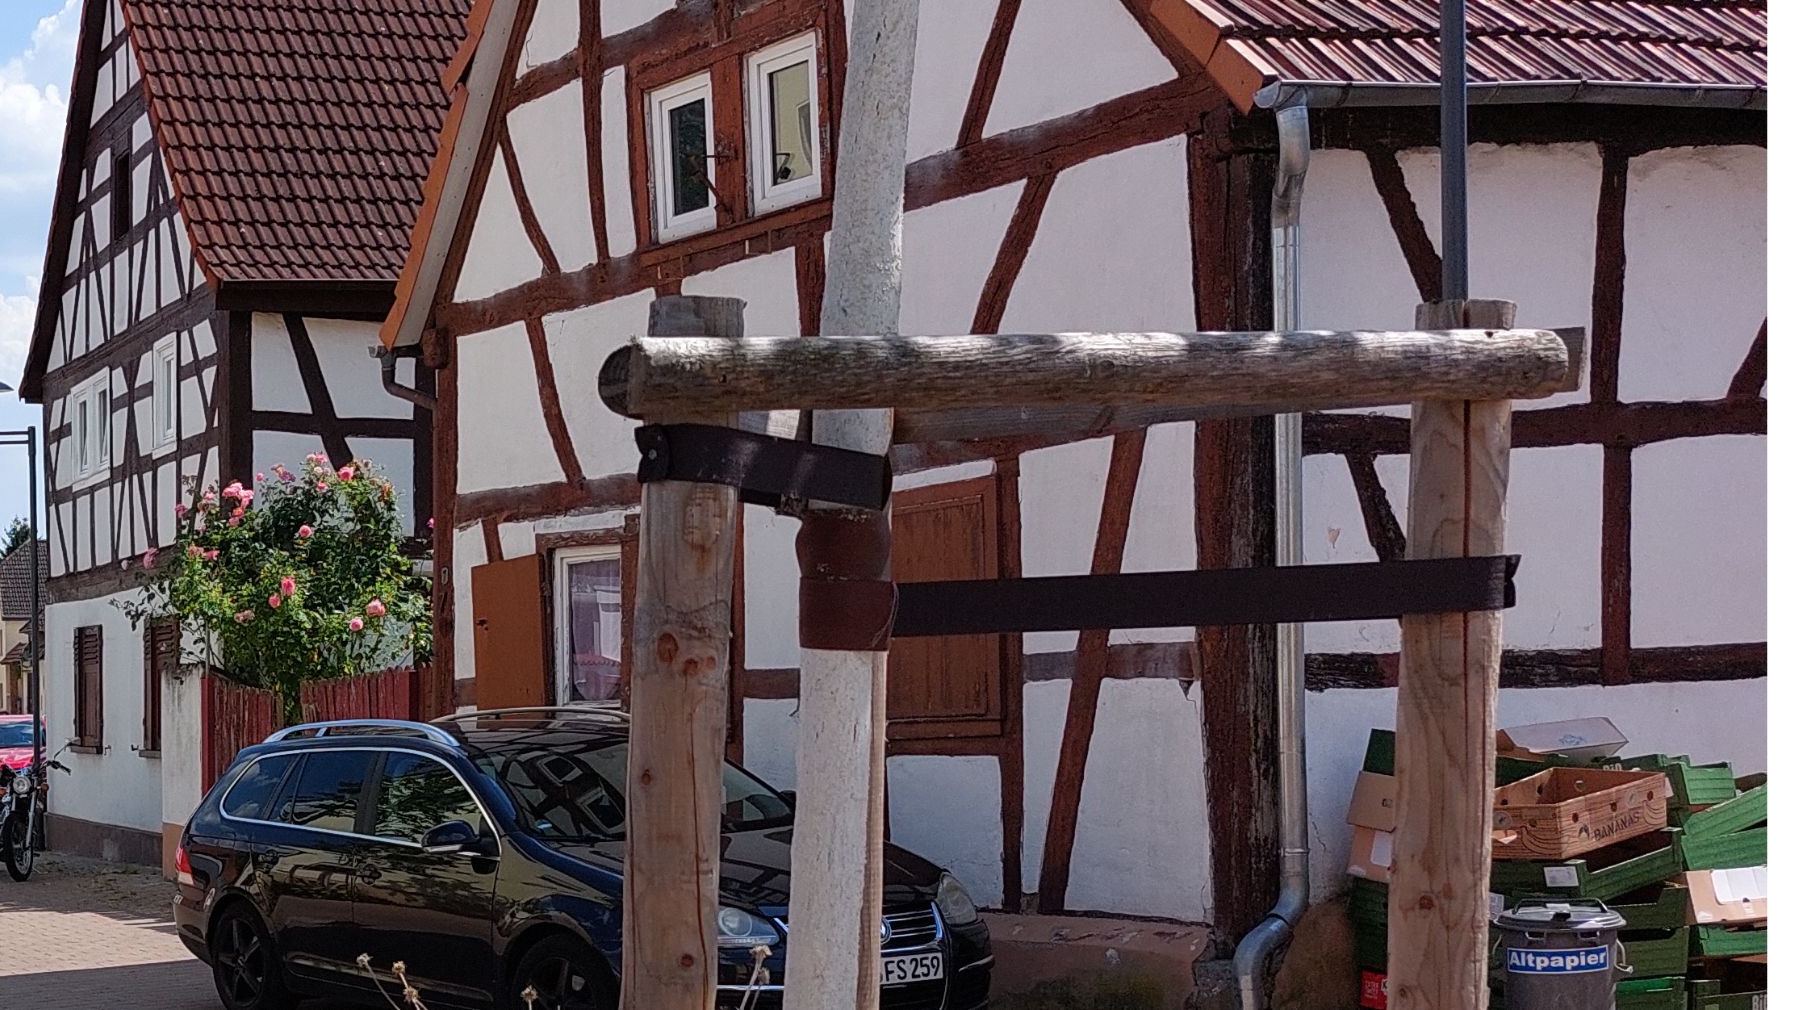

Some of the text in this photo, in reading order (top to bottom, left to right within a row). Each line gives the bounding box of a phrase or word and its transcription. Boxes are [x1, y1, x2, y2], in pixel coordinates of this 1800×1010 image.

[1594, 811, 1640, 841] BANANAS
[884, 955, 940, 982] FS 259
[1509, 951, 1606, 970] Altpapier
